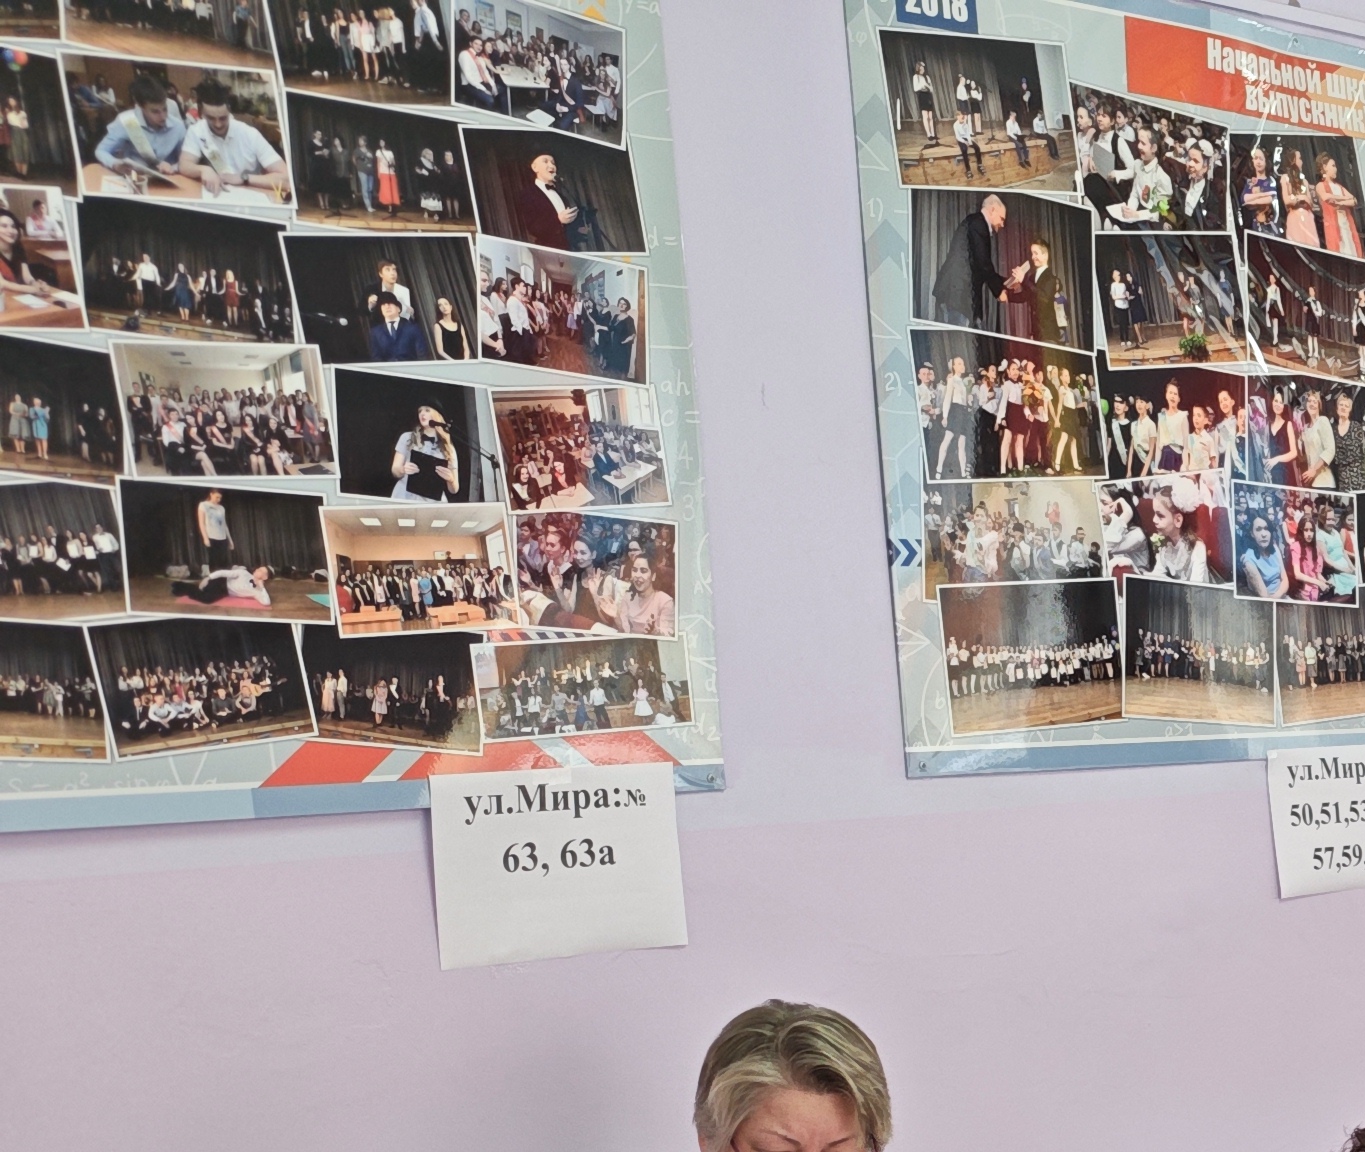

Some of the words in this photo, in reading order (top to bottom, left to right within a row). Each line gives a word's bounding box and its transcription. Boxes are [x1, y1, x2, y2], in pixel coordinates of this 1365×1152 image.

[1206, 37, 1322, 95] Начальной
[502, 842, 550, 877] 63,
[560, 838, 616, 868] 63а
